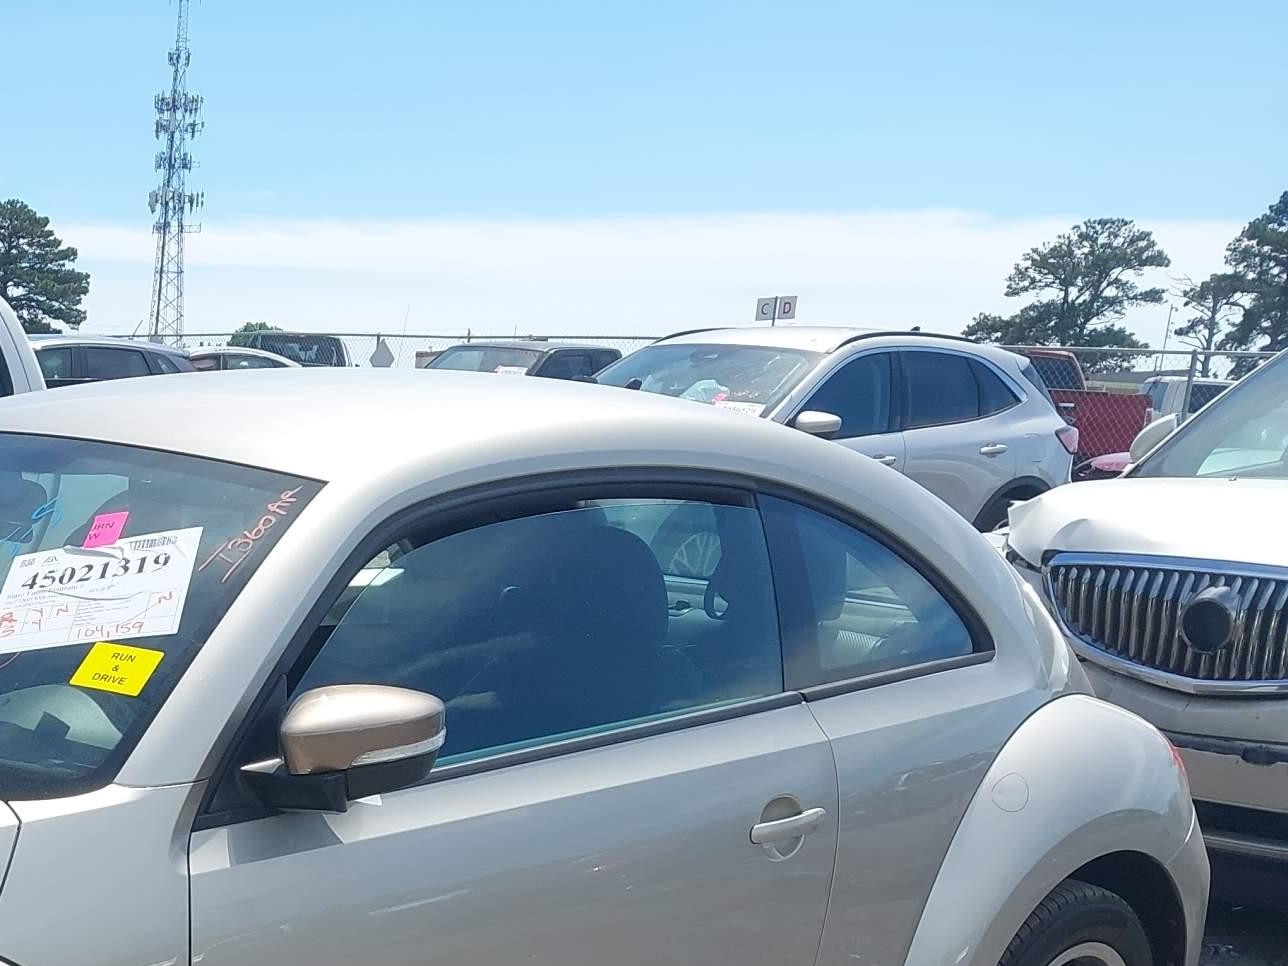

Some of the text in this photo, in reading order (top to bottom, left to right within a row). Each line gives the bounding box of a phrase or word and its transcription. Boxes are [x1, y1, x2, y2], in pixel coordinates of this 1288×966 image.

[761, 302, 770, 315] C
[782, 301, 792, 314] D
[21, 552, 171, 590] 45021319
[77, 621, 145, 639] 104,159
[110, 652, 136, 663] RUN
[111, 664, 120, 672] &
[91, 672, 127, 686] DRIVE
